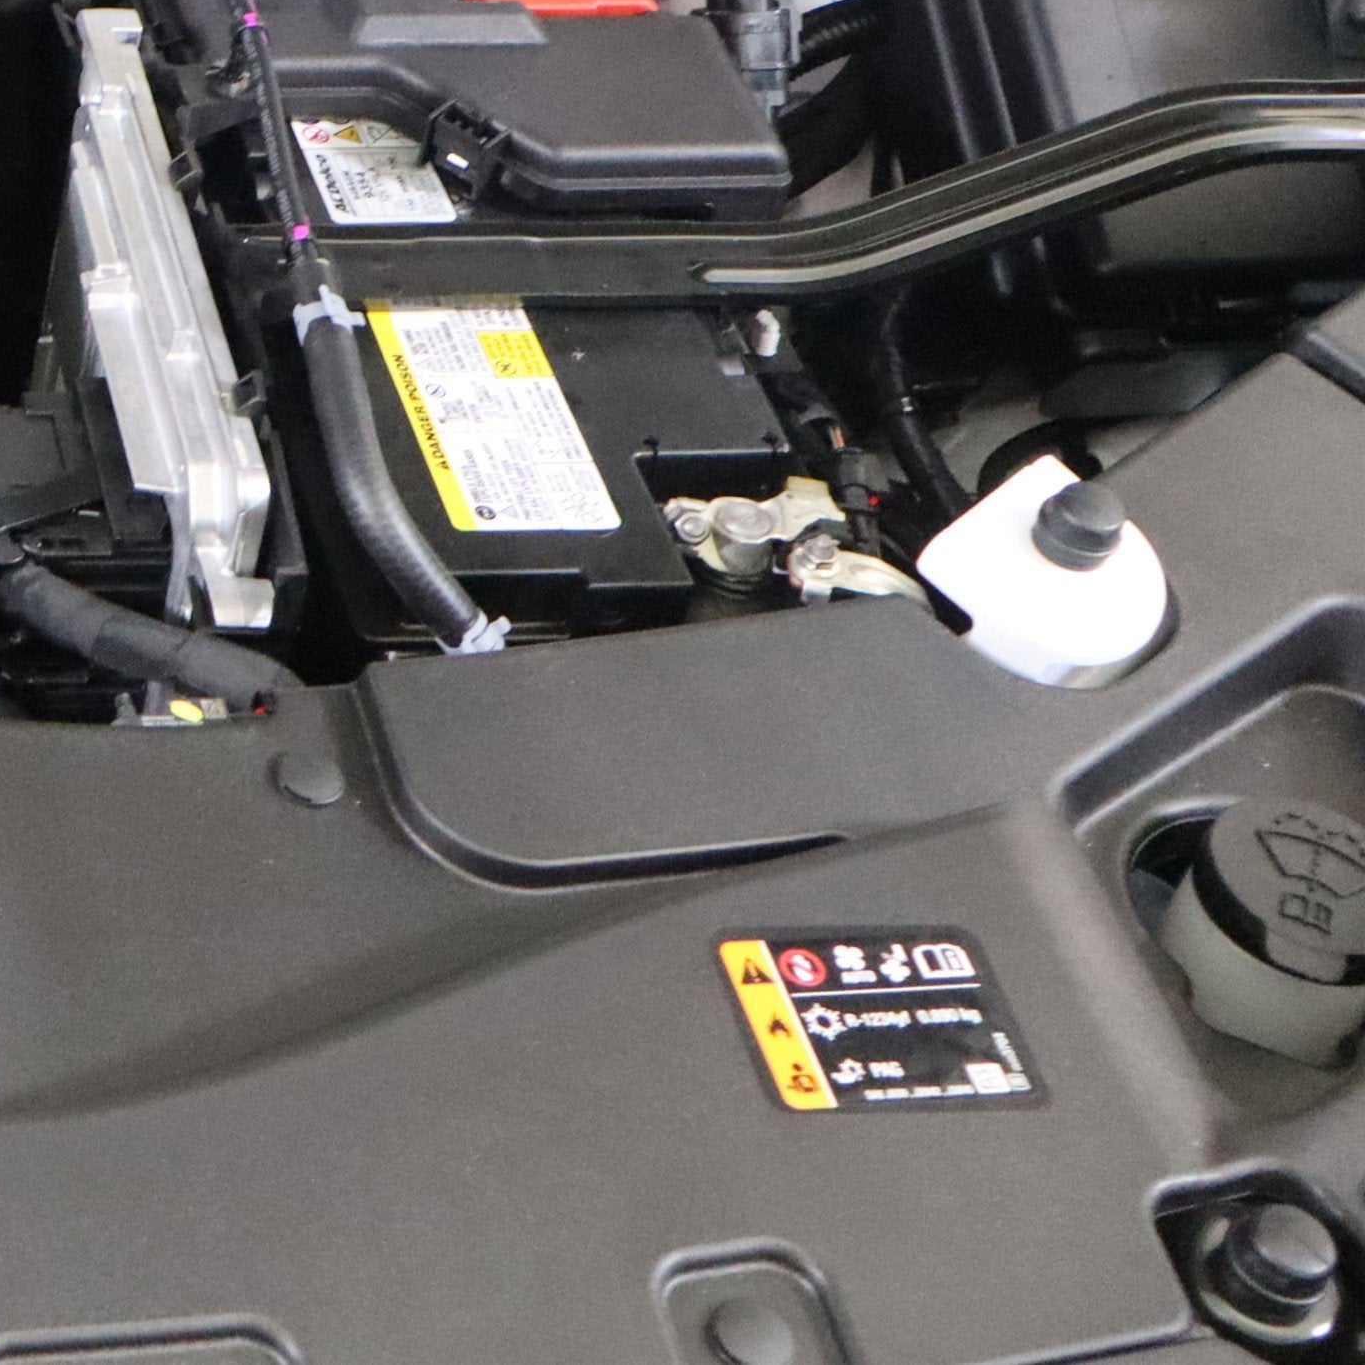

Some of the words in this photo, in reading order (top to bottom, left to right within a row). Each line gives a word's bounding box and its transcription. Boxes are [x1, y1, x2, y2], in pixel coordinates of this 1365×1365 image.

[312, 154, 349, 213] ACDelco
[391, 353, 421, 400] POISON
[412, 405, 447, 462] DANGER
[868, 1061, 906, 1078] PAG
